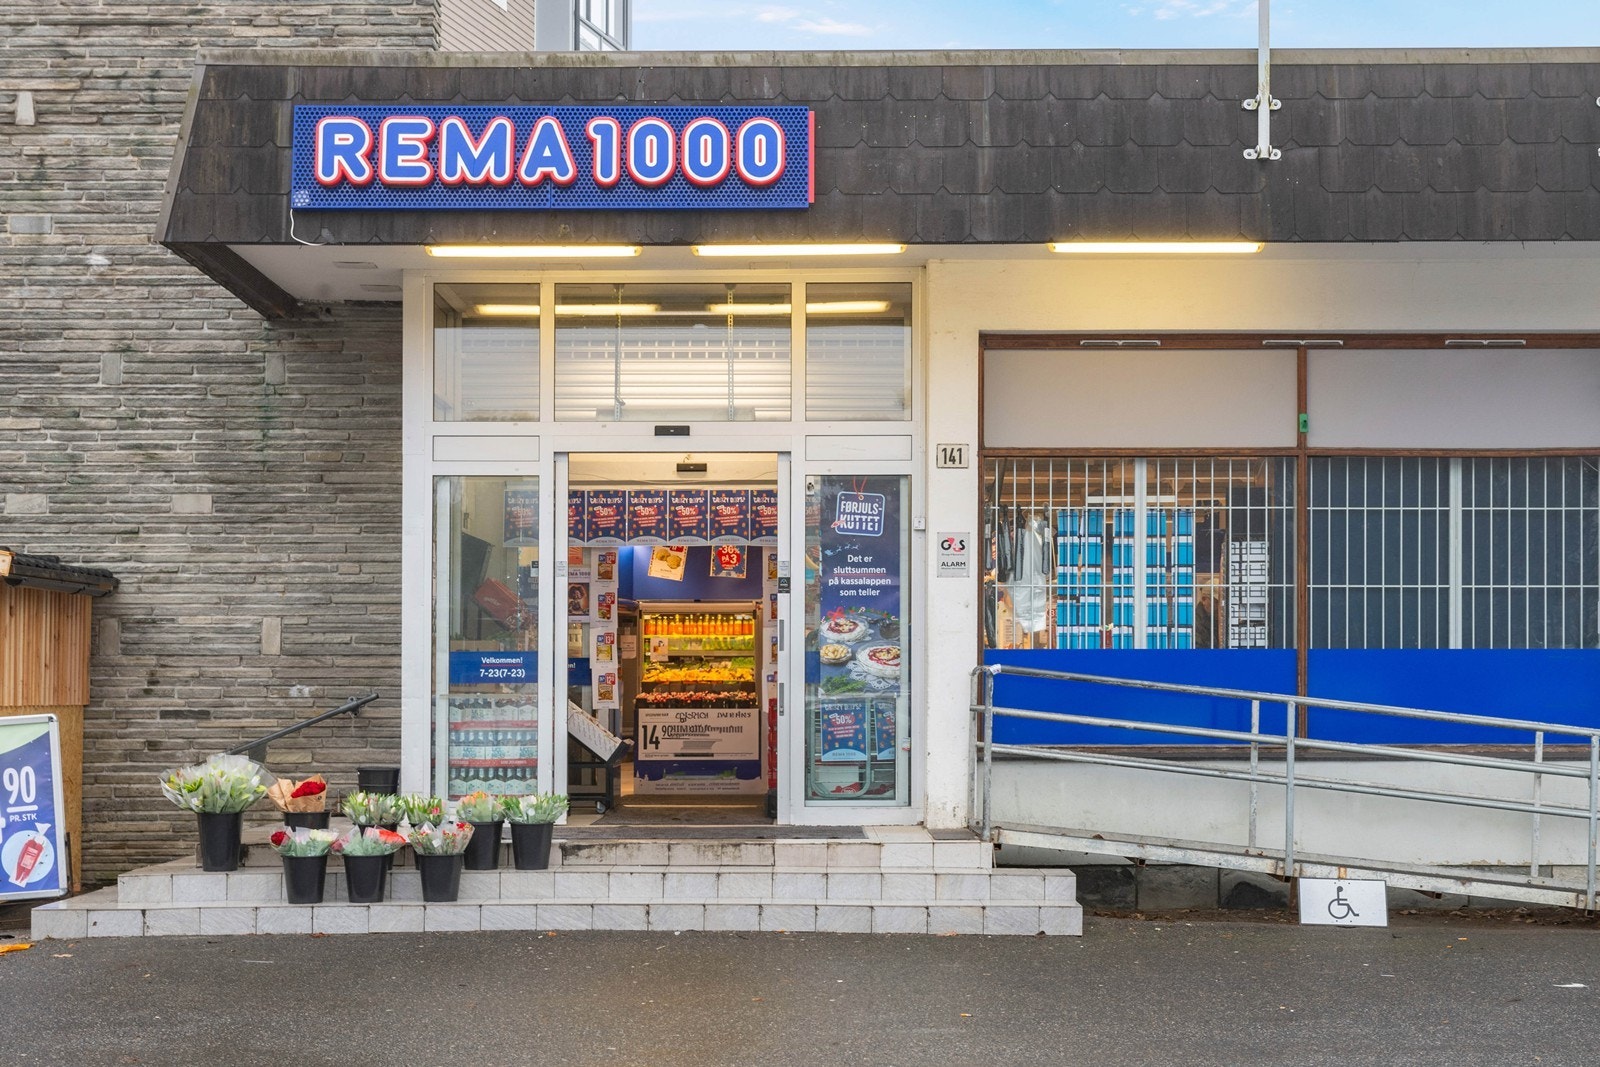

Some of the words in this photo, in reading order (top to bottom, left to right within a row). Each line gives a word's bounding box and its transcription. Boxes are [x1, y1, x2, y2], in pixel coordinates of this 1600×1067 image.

[315, 116, 577, 187] REMA
[587, 116, 786, 187] 1000
[941, 447, 962, 465] 141
[840, 501, 882, 514] FØRJULS-
[834, 566, 886, 574] sluttsummen
[828, 577, 839, 586] på
[840, 577, 891, 585] kassalappen
[859, 588, 880, 596] teller
[480, 669, 526, 678] 7-23(7-23)
[642, 725, 660, 750] 14
[3, 766, 36, 804] 90
[22, 813, 37, 821] STK
